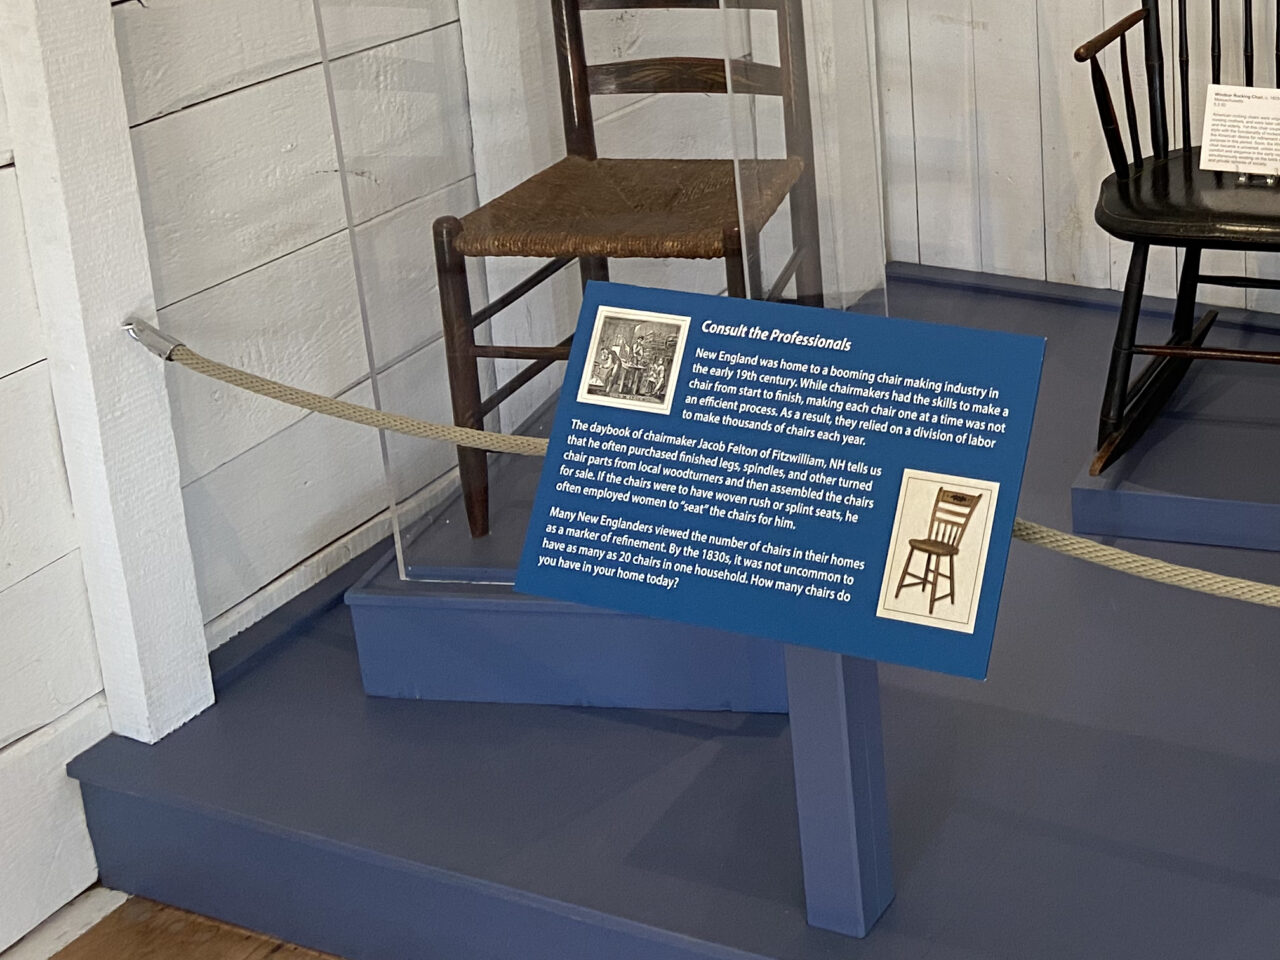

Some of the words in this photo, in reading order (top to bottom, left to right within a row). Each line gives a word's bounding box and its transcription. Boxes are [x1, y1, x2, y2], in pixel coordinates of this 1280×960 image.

[701, 320, 748, 337] Consult
[748, 326, 769, 340] the
[769, 329, 852, 351] Professionals
[692, 363, 709, 374] the
[709, 367, 734, 380] early
[736, 369, 757, 381] 19th
[759, 374, 798, 389] century.
[800, 377, 828, 391] While
[829, 382, 890, 400] chairmakers
[891, 390, 912, 403] had
[913, 393, 930, 406] the
[931, 396, 957, 409] skills
[959, 401, 970, 411] to
[972, 403, 1001, 416] make
[1002, 408, 1009, 417] a
[695, 347, 718, 360] New
[718, 351, 759, 365] England
[759, 358, 779, 368] was
[779, 358, 808, 372] home
[810, 364, 821, 374] to
[822, 367, 829, 375] a
[830, 365, 876, 384] booming
[877, 372, 903, 385] chair
[903, 377, 943, 393] making
[944, 381, 987, 399] industry
[988, 387, 999, 399] in
[682, 409, 693, 420] to
[693, 412, 720, 424] make
[722, 415, 773, 431] thousands
[774, 422, 786, 433] of
[786, 424, 815, 438] chairs
[817, 430, 840, 442] each
[841, 434, 866, 446] year.
[685, 395, 698, 404] an
[699, 396, 738, 410] efficient
[738, 403, 778, 416] process.
[779, 407, 793, 418] As
[794, 411, 801, 420] a
[802, 412, 832, 426] result,
[835, 415, 858, 430] they
[858, 419, 888, 432] relied
[889, 425, 903, 434] on
[904, 427, 911, 436] a
[913, 426, 953, 442] division
[955, 433, 968, 444] of
[968, 433, 996, 448] labor
[689, 378, 713, 390] chair
[714, 381, 737, 394] from
[738, 386, 762, 398] start
[763, 389, 774, 399] to
[775, 390, 804, 405] finish,
[806, 396, 844, 412] making
[845, 402, 869, 413] each
[871, 404, 897, 417] chair
[898, 410, 918, 420] one
[919, 412, 930, 422] at
[931, 415, 938, 423] a
[940, 414, 964, 427] time
[965, 420, 986, 430] was
[987, 423, 1006, 433] not
[546, 524, 557, 533] as
[557, 526, 564, 535] a
[565, 528, 600, 540] marker
[600, 532, 613, 542] of
[612, 534, 667, 553] refinement.
[668, 543, 682, 557] By
[683, 545, 699, 558] the
[702, 549, 732, 565] 1830s,
[734, 554, 742, 566] it
[743, 558, 763, 569] was
[764, 562, 782, 573] not
[783, 565, 841, 583] uncommon
[843, 574, 854, 585] to
[549, 506, 577, 522] Many
[577, 511, 599, 524] New
[600, 515, 653, 533] Englanders
[655, 525, 690, 540] viewed
[691, 530, 707, 543] the
[708, 536, 749, 549] number
[749, 540, 761, 551] of
[761, 542, 791, 557] chairs
[792, 547, 803, 559] in
[805, 549, 829, 563] their
[830, 553, 865, 570] homes
[538, 555, 557, 566] you
[558, 556, 581, 571] have
[582, 561, 592, 572] in
[592, 565, 616, 576] your
[616, 567, 645, 582] home
[646, 573, 679, 590] today?
[542, 537, 566, 551] have
[566, 544, 577, 553] as
[578, 546, 606, 561] many
[606, 551, 617, 560] as
[618, 551, 632, 563] 20
[632, 554, 661, 568] chairs
[662, 558, 672, 570] in
[674, 563, 693, 574] one
[694, 563, 748, 584] household.
[750, 574, 774, 588] How
[775, 581, 804, 596] many
[805, 584, 835, 599] chairs
[836, 589, 851, 602] do
